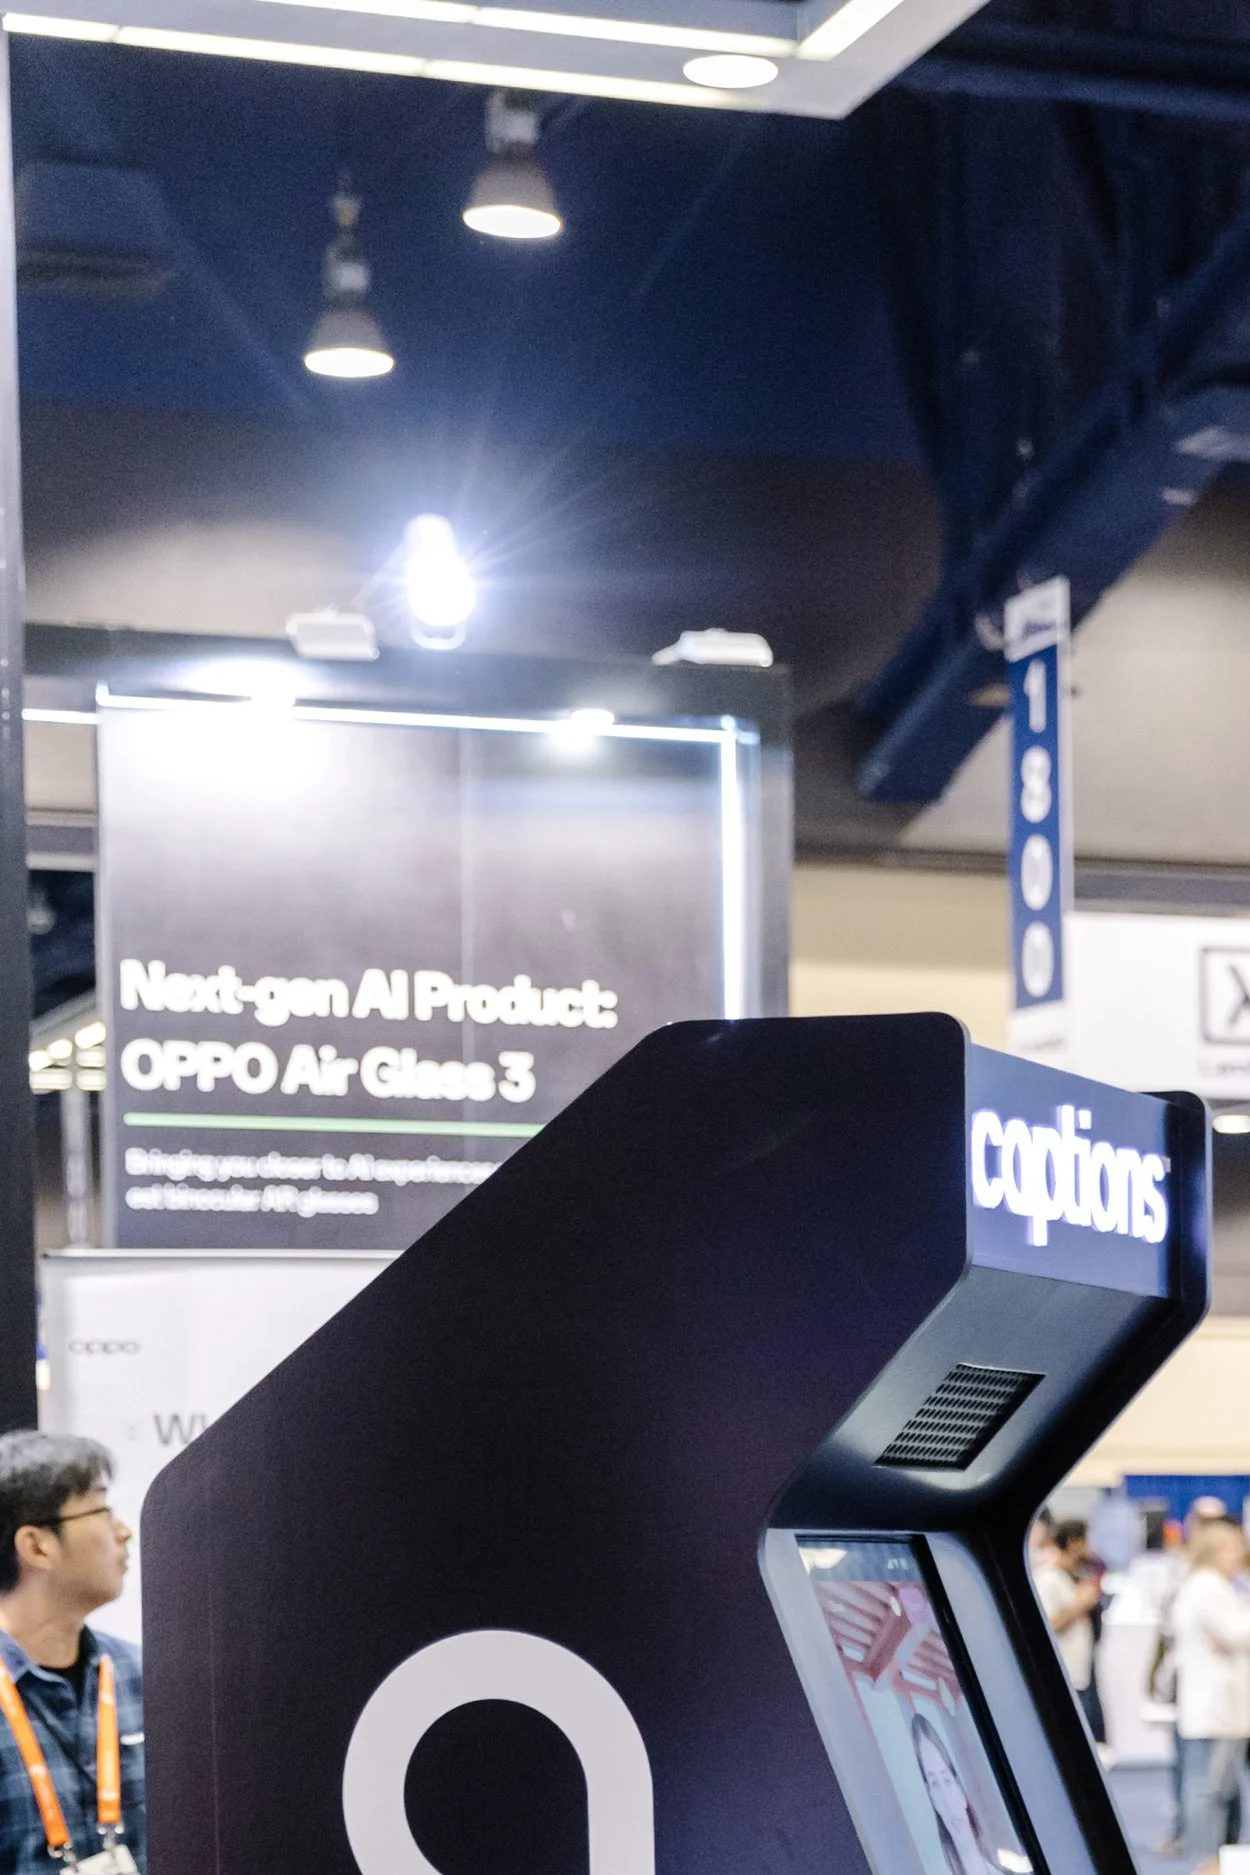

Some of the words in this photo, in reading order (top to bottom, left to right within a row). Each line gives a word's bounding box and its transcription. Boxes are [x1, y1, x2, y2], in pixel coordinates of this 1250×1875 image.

[1021, 658, 1054, 999] 1800
[120, 958, 349, 1026] Next-gen
[352, 968, 408, 1021] AI
[414, 970, 618, 1029] Product:
[120, 1037, 278, 1095] OPPO
[280, 1044, 358, 1097] Air
[360, 1046, 496, 1102] Glass
[498, 1051, 537, 1103] 3
[971, 1105, 1169, 1247] captions
